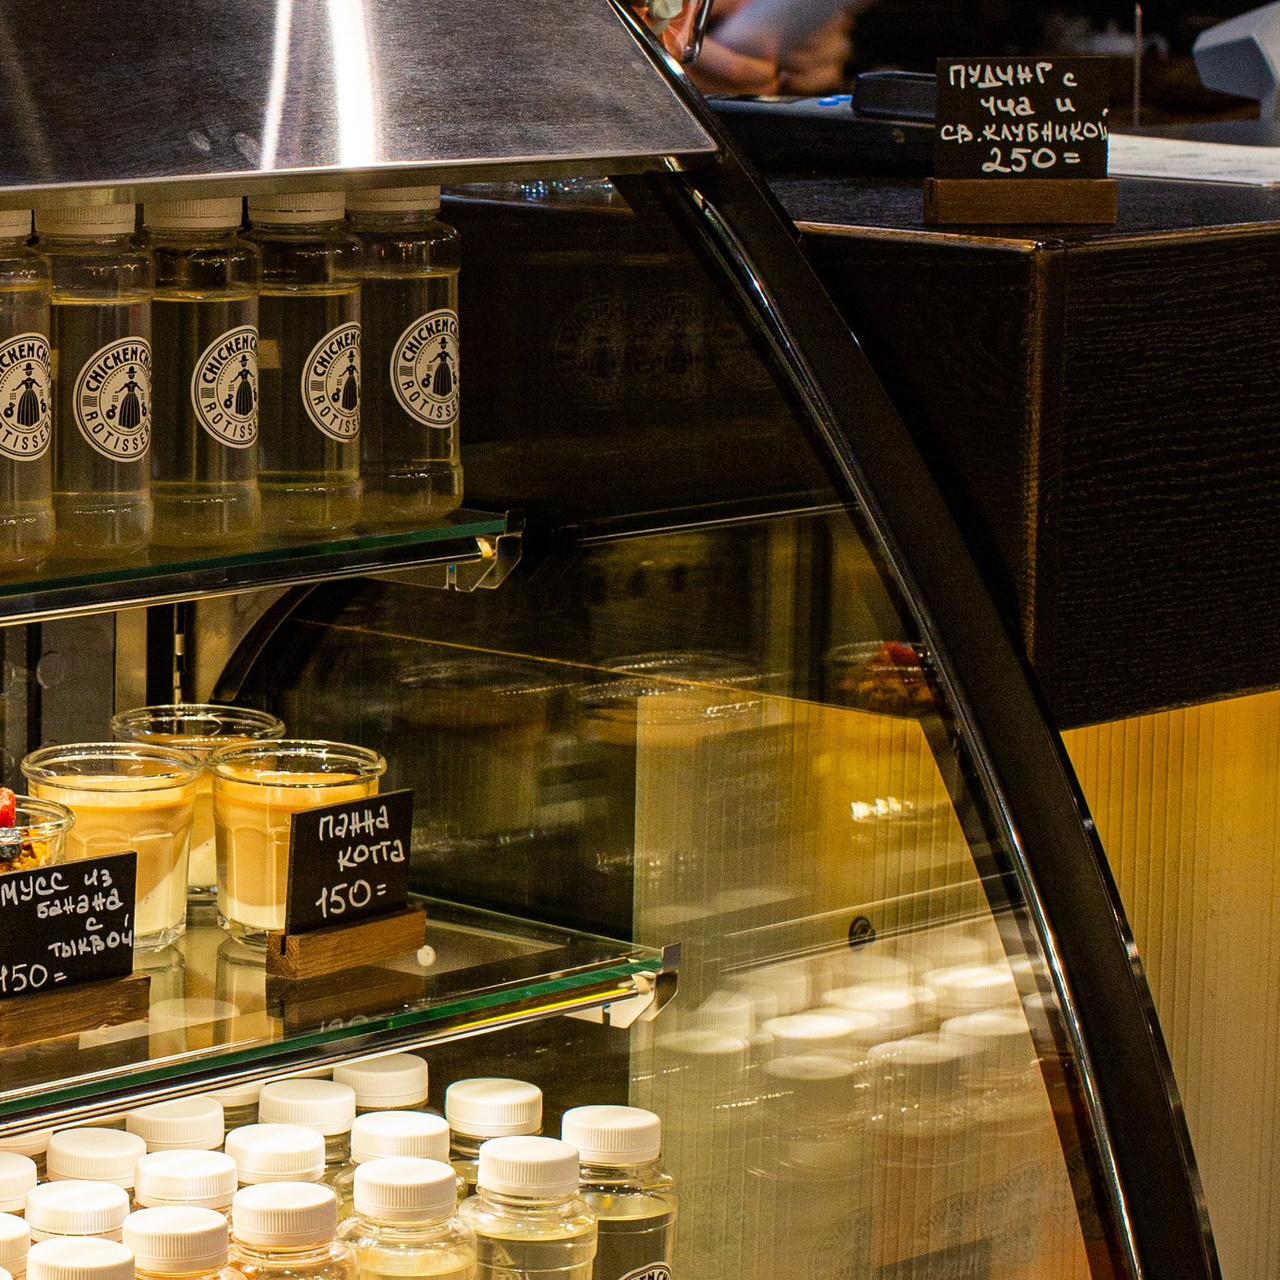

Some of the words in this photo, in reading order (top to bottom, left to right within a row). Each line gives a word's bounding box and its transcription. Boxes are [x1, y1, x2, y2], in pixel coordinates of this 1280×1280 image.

[203, 337, 248, 382] CHICKEN
[314, 331, 357, 377] CHICKEN
[406, 318, 449, 363] CHICKEN
[86, 347, 138, 391] CHICKEN
